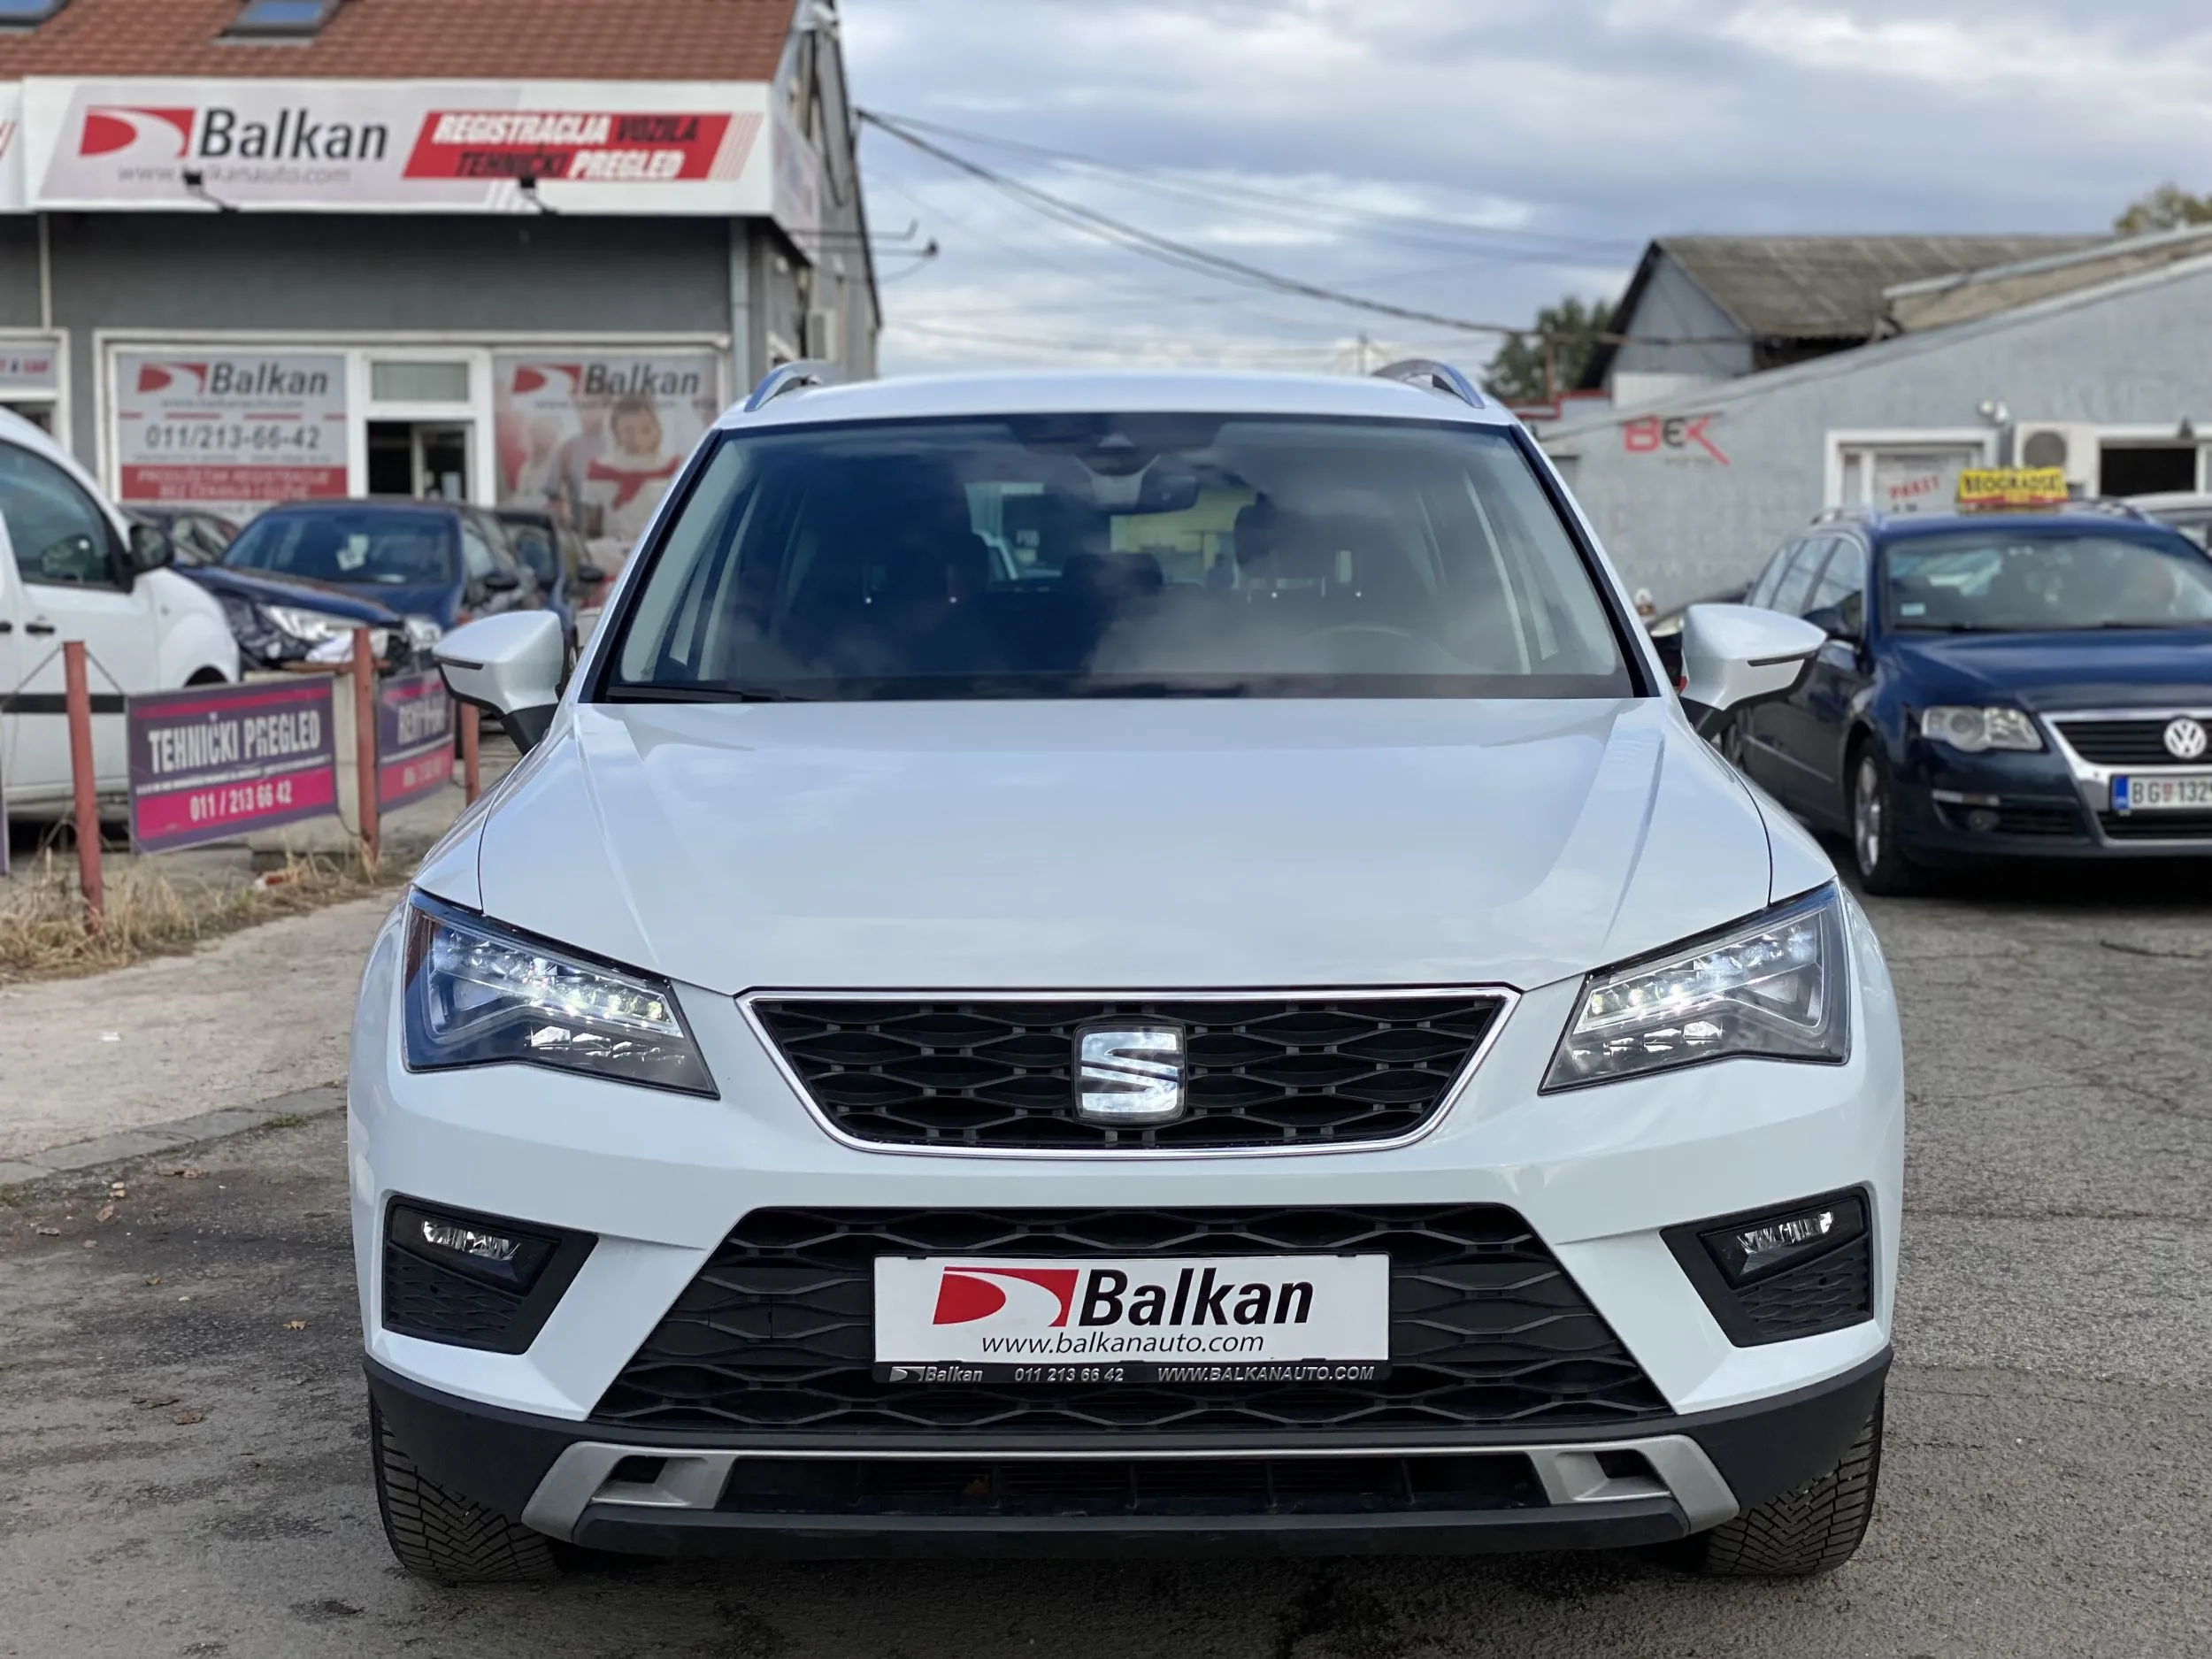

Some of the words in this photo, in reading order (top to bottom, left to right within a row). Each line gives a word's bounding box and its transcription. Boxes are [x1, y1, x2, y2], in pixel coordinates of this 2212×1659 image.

[199, 107, 389, 160] Balkan
[432, 113, 611, 145] REGISTRACIJA
[615, 115, 699, 142] VOZILA
[567, 149, 685, 179] PREGLED
[211, 362, 328, 396] Balkan
[585, 363, 699, 396] Balkan
[144, 424, 321, 449] 011/213-66-42
[148, 711, 239, 774] TEHNIČKI
[243, 710, 321, 759] PREGLED
[190, 793, 215, 822] 011
[229, 786, 254, 814] 213
[276, 779, 293, 804] 42
[2132, 781, 2160, 803] BG
[2178, 781, 2212, 803] 132
[1079, 1267, 1314, 1327] Balkan
[982, 1331, 1263, 1355] www.balkanauto.com
[925, 1366, 983, 1382] Balkan
[1014, 1368, 1041, 1381] 011
[1047, 1368, 1076, 1381] 213
[1080, 1368, 1100, 1381] 66
[1104, 1368, 1124, 1381] 42
[1157, 1365, 1375, 1382] WWW.BALKANAUTO.COM
